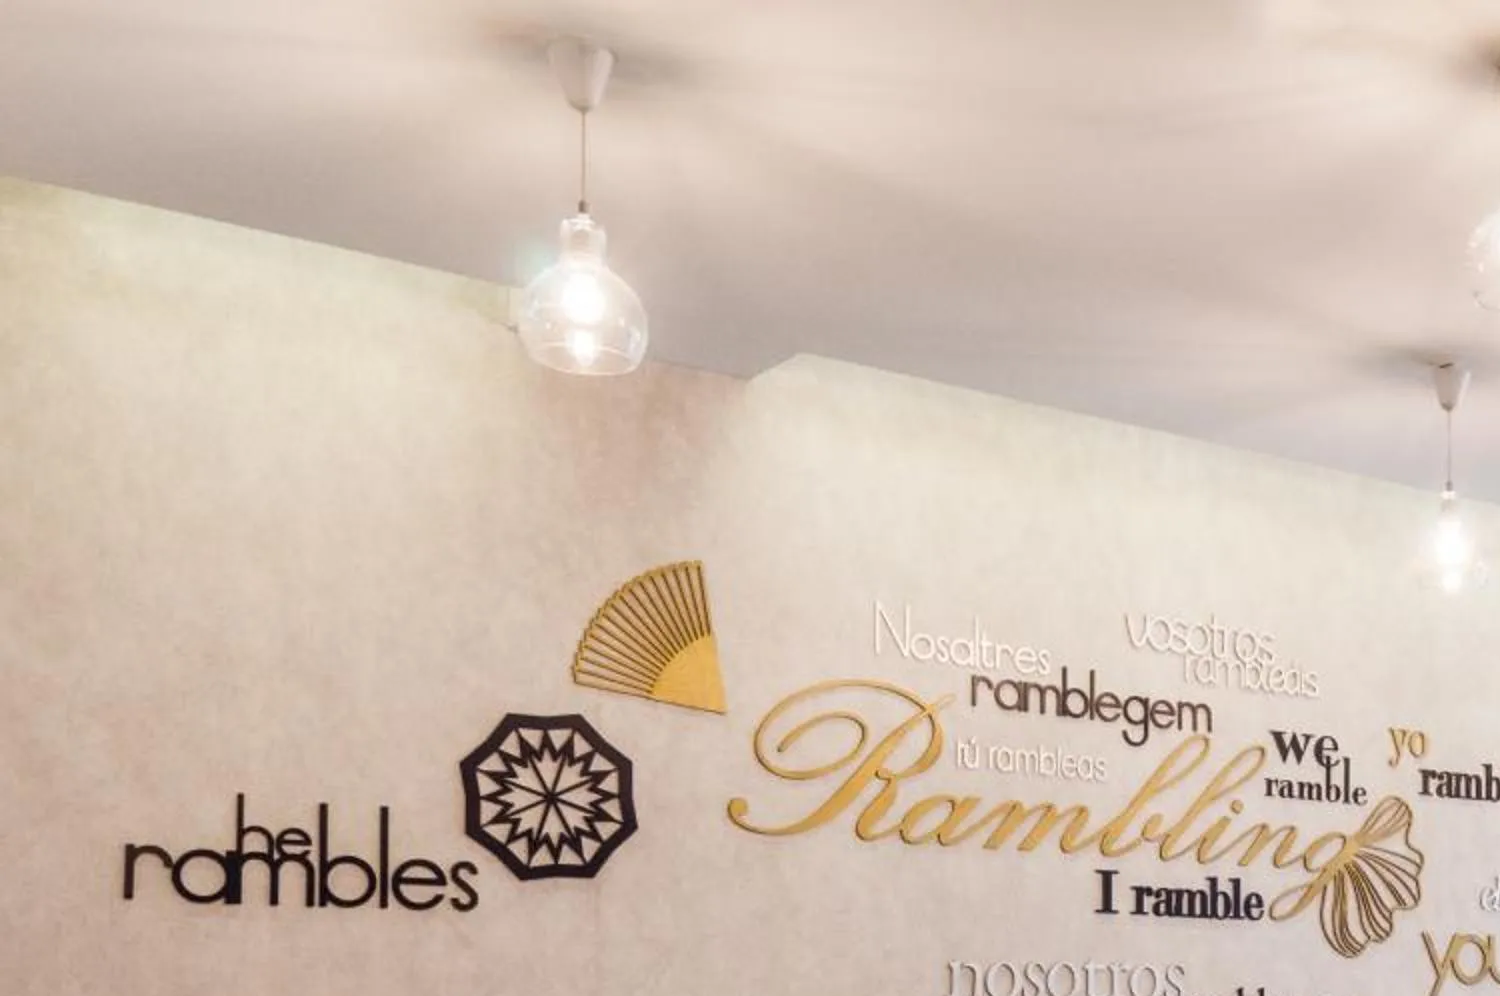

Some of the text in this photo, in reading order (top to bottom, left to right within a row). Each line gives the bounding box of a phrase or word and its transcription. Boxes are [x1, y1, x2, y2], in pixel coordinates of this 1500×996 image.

[873, 600, 1050, 676] Nosaltres
[1124, 612, 1277, 667] vosotros
[970, 665, 1213, 747] ramblegem
[988, 743, 1108, 782] rambleas
[1269, 728, 1341, 768] we
[1387, 726, 1428, 768] yo
[727, 678, 1375, 930] Rambling
[1264, 757, 1368, 806] ramble
[236, 793, 313, 858] he
[123, 802, 479, 912] rambles
[1094, 870, 1265, 921] I ramble
